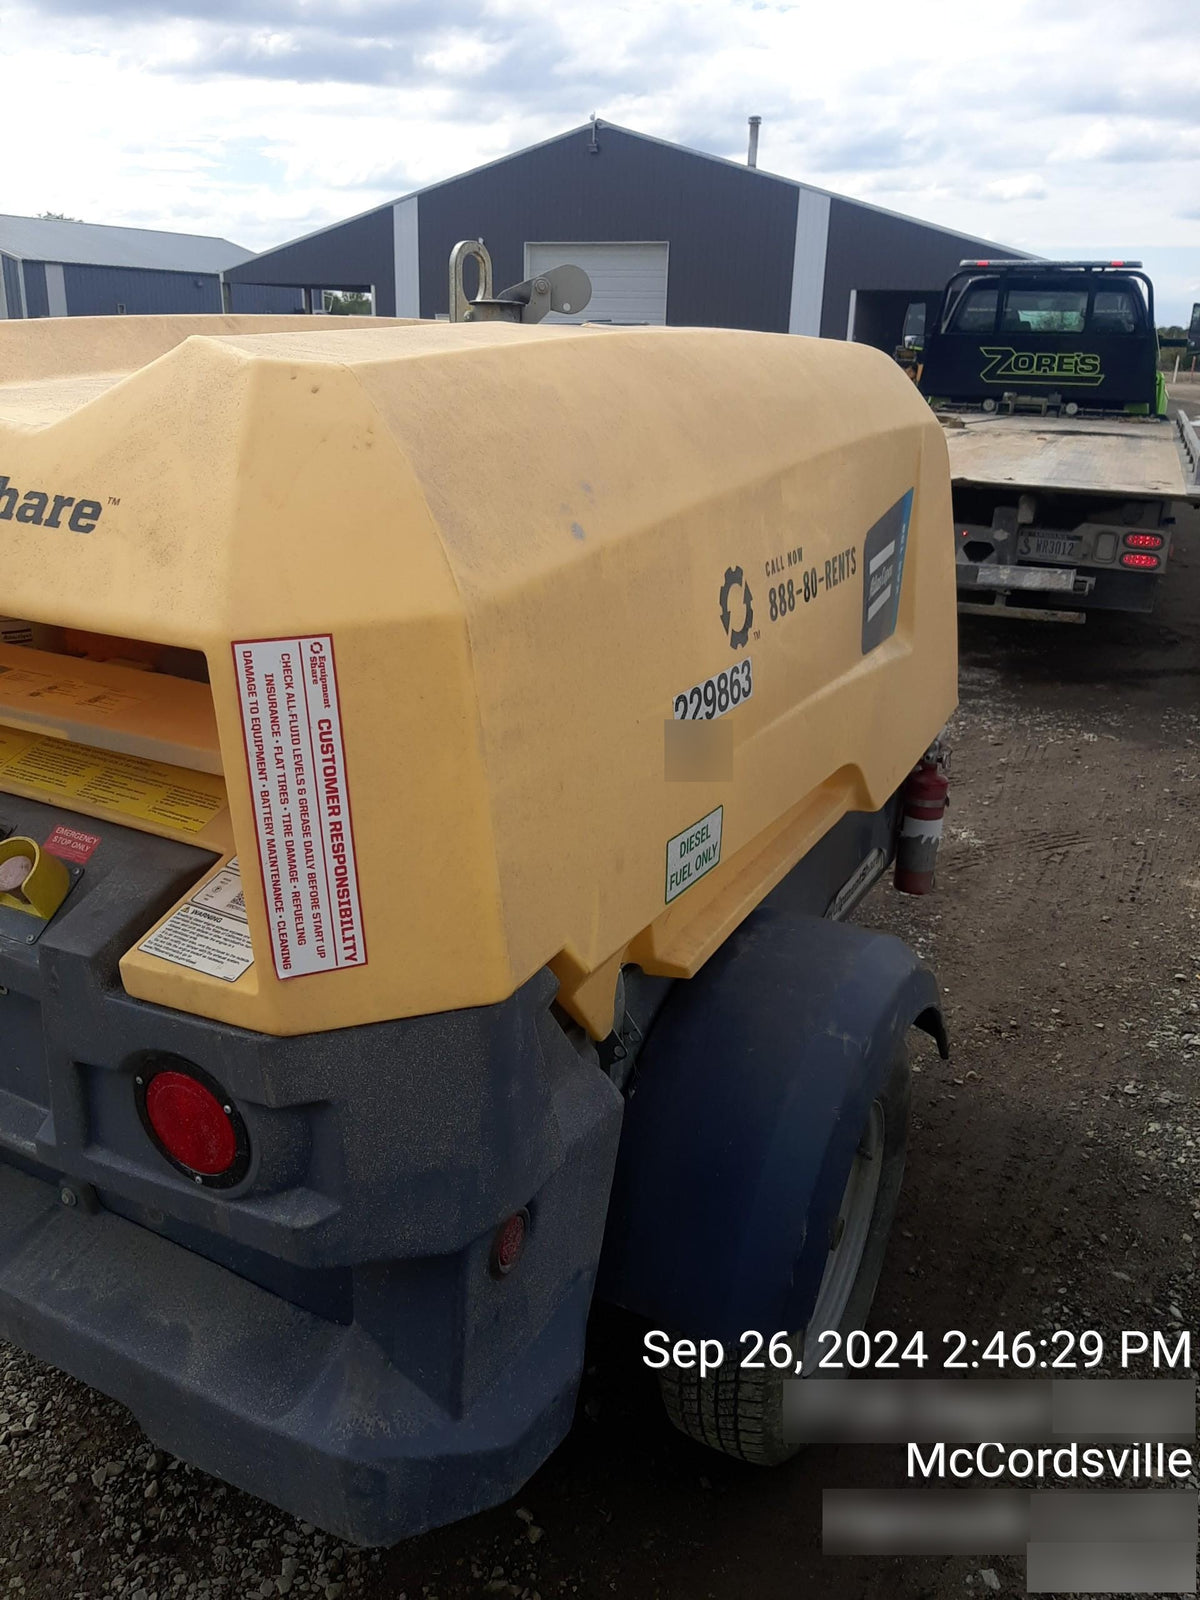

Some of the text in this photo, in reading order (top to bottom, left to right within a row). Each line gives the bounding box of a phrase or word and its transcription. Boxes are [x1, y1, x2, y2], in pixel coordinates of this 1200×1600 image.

[980, 346, 1105, 386] ZORE'S
[765, 547, 803, 577] CALL NOW
[768, 546, 857, 622] 888-80-RENTS
[281, 653, 295, 690] CHECK
[309, 656, 319, 685] Share
[318, 655, 331, 709] Equipment
[286, 692, 297, 712] ALL
[674, 659, 752, 720] 229863
[289, 713, 301, 746] FLUID
[292, 748, 306, 786] LEVELS
[242, 650, 292, 970] DAMAGE TO EQUIPMENT BATTERY MAINTENANCE CLEANING
[264, 673, 307, 946] INSURANCE FLAT TIRES TIRE DAMAGE REFUELING
[298, 798, 312, 838] GREASE
[52, 835, 72, 846] STOP
[71, 841, 91, 853] ONLY
[55, 826, 99, 845] EMERGENCY
[317, 718, 358, 962] CUSTOMER RESPONSIBILITY
[680, 824, 711, 859] DIESEL
[303, 840, 316, 870] DAILY
[669, 841, 718, 891] FUEL ONLY
[307, 872, 321, 910] BEFORE
[191, 908, 223, 924] WARNING
[312, 912, 325, 943] START
[316, 945, 327, 959] UP
